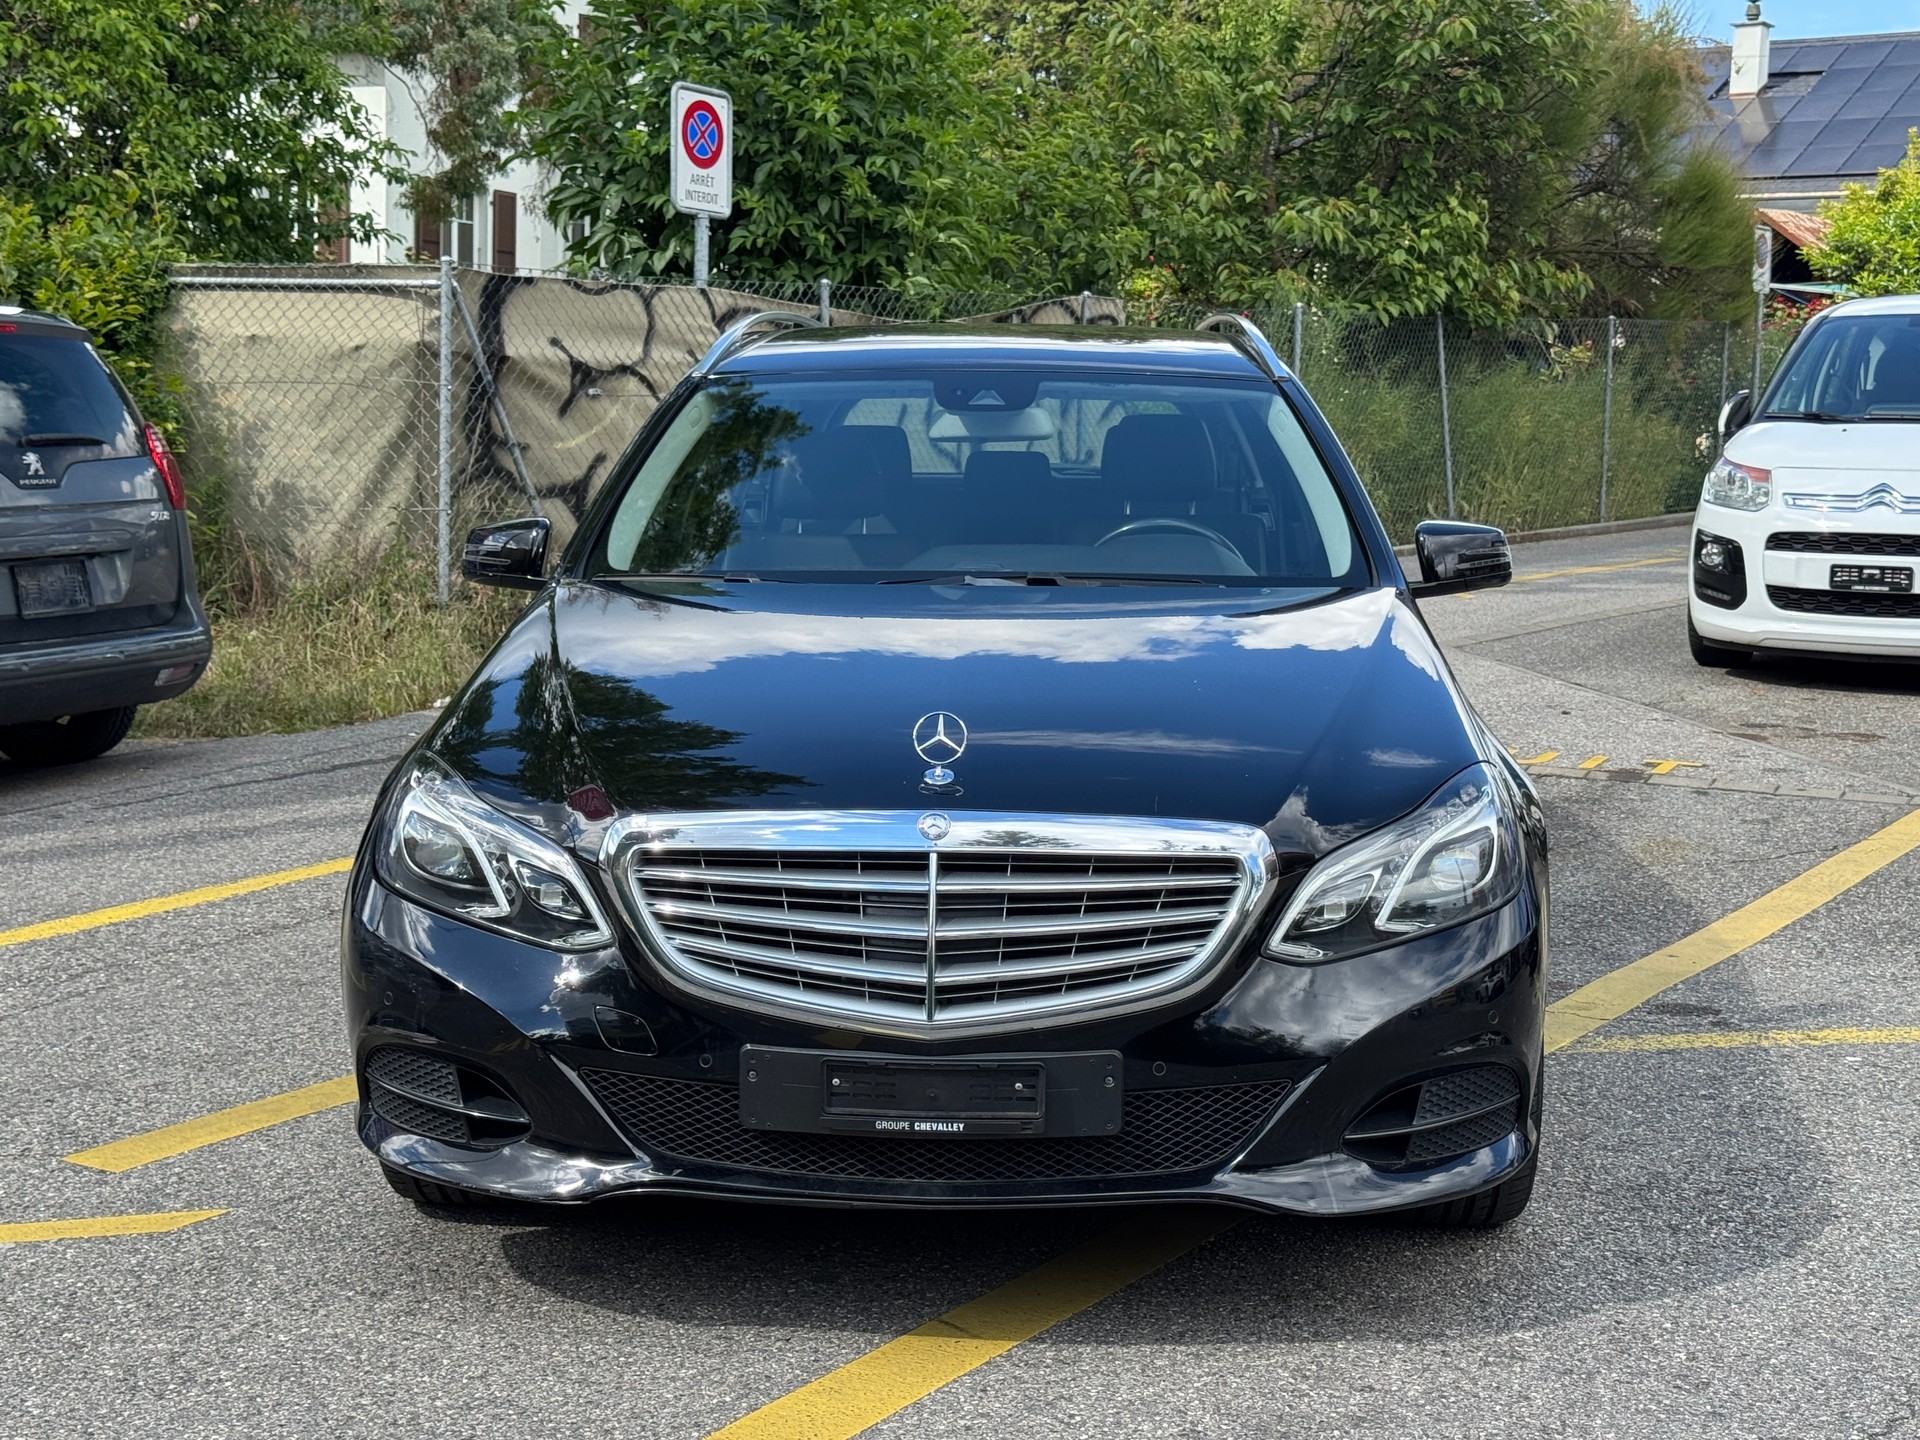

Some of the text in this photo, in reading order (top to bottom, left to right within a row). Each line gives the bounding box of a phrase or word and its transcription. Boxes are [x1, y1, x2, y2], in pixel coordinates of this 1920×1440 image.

[689, 173, 715, 188] ARRÊT
[685, 189, 718, 205] INTERDIT
[875, 1120, 965, 1131] GROUPE CHEVALLEY
